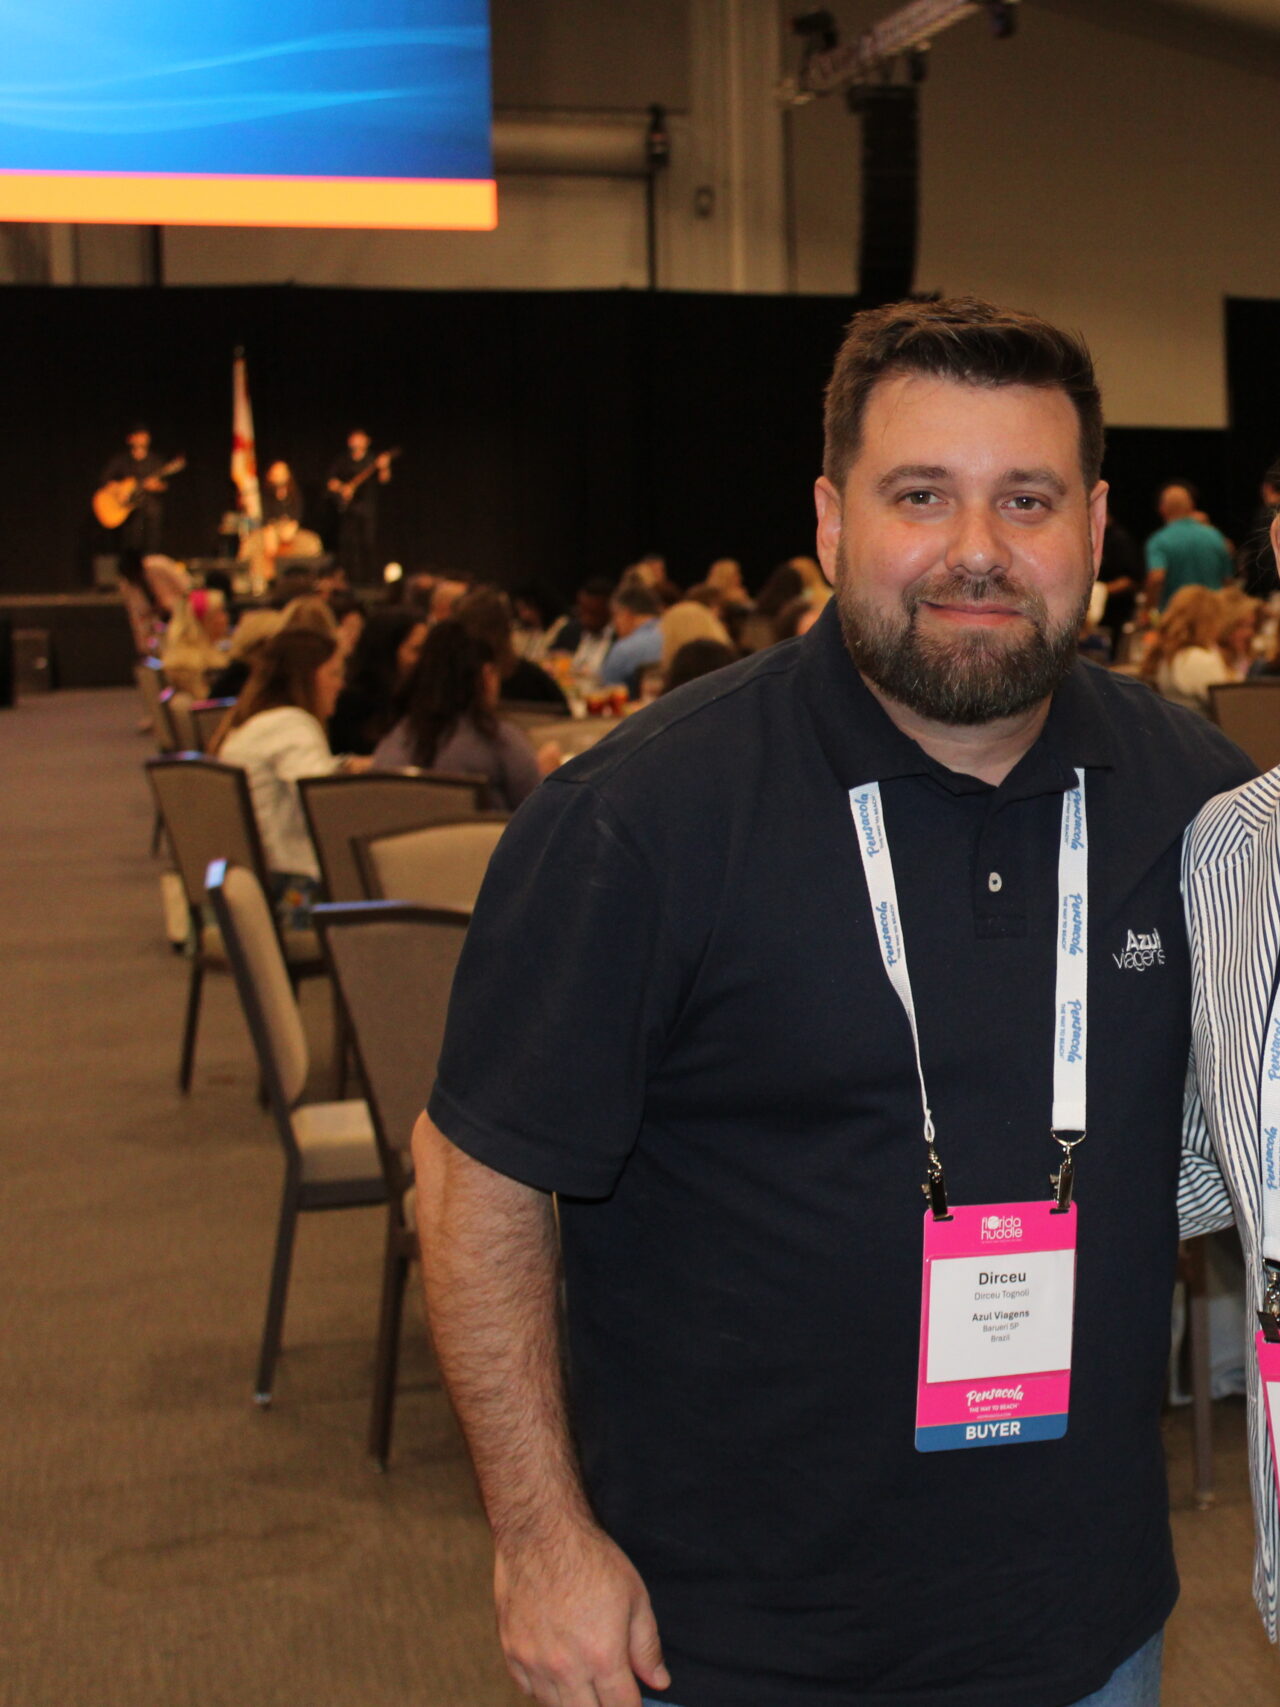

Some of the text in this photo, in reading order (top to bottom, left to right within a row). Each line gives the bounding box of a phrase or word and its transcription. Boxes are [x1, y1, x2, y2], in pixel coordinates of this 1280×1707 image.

[855, 793, 880, 857] Pensacola
[1071, 789, 1084, 850] Pensacola
[876, 901, 897, 967] Pensacola
[1069, 892, 1084, 956] Pensacola
[1126, 928, 1161, 951] Azul
[1067, 998, 1082, 1063] Pensacola
[1264, 1126, 1278, 1190] Pensacola
[981, 1226, 1023, 1240] huddle
[979, 1271, 1026, 1285] Dirceu
[974, 1291, 1001, 1301] Dirceu
[972, 1310, 1030, 1321] Azul Viagens
[990, 1334, 1010, 1343] Brazil
[966, 1384, 1025, 1407] Pensacola
[966, 1421, 1021, 1440] BUYER
